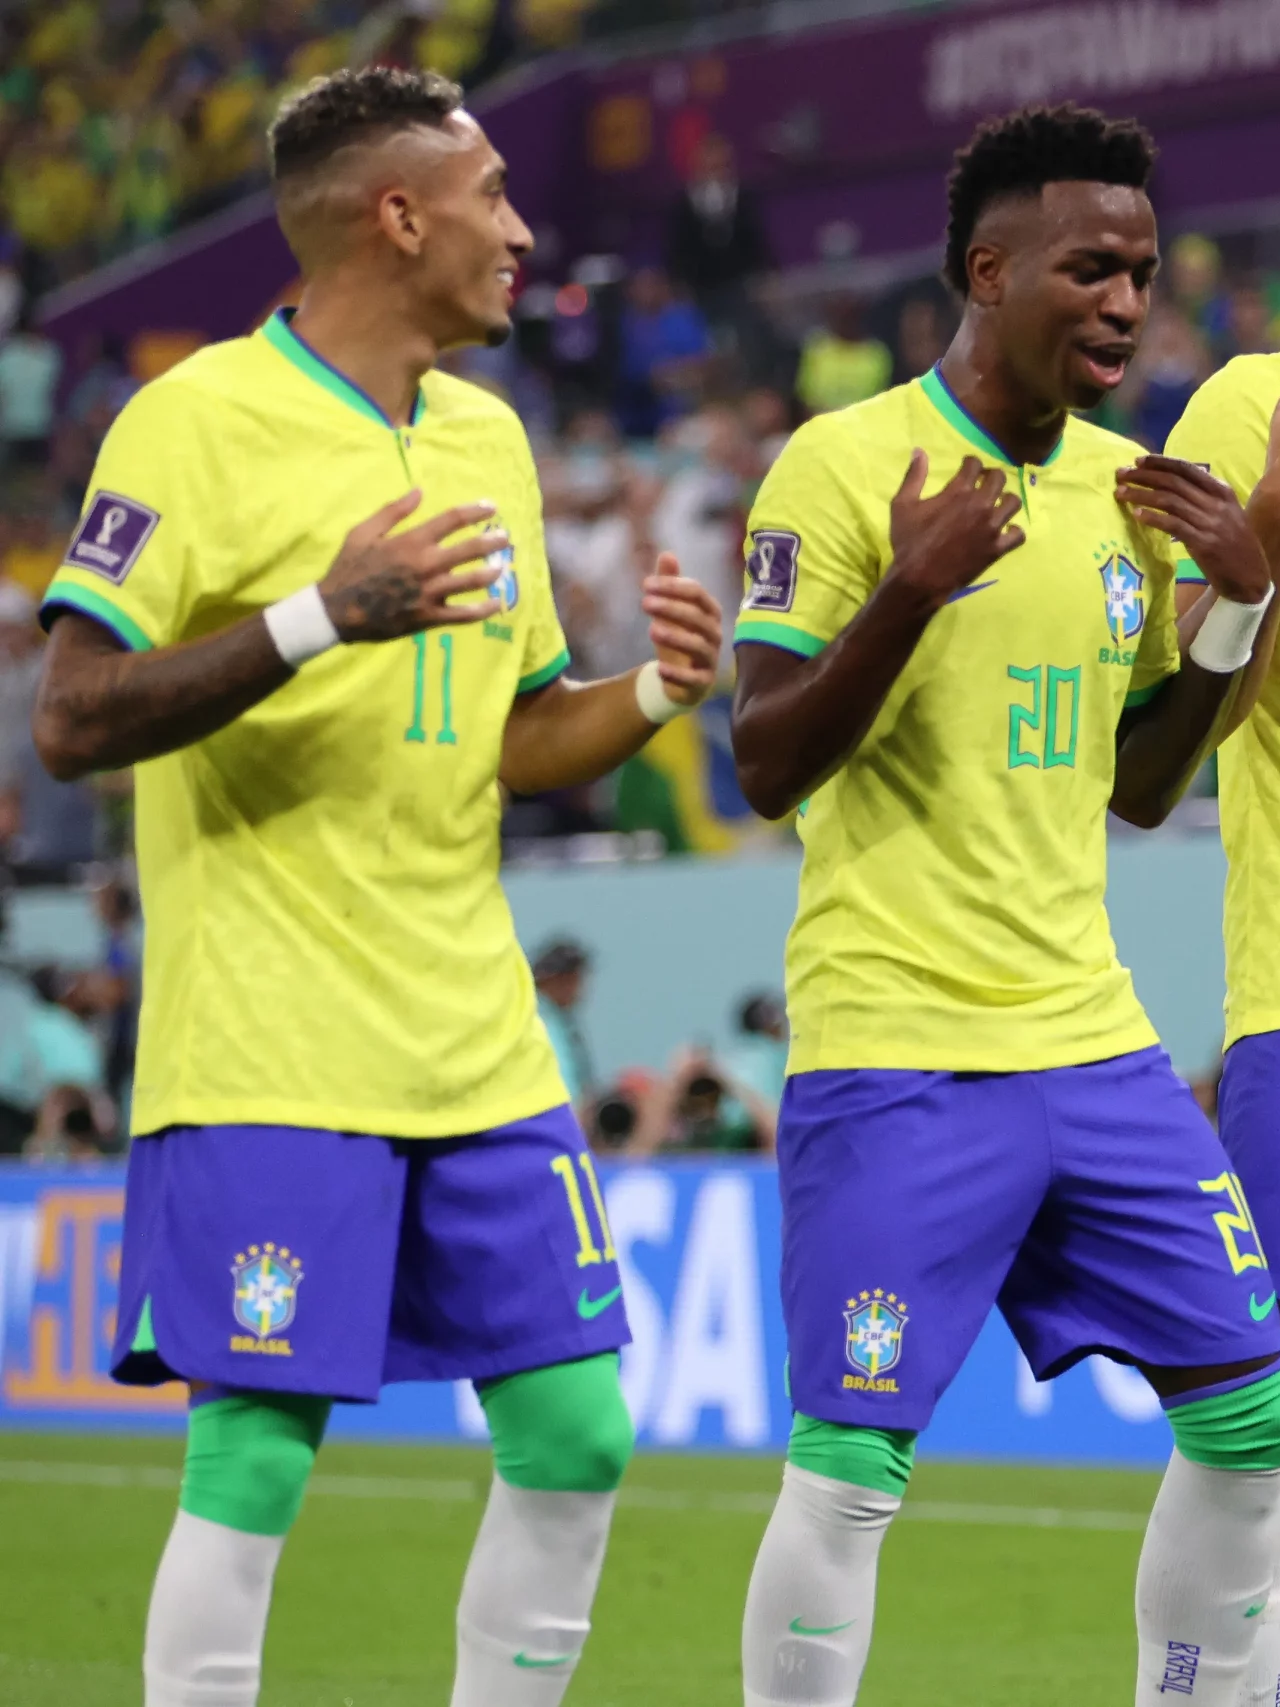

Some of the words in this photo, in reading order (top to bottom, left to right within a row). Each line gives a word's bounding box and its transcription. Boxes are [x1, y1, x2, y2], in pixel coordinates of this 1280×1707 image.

[1110, 590, 1127, 602] CBF
[404, 631, 457, 744] 11
[1007, 664, 1081, 770] 20
[550, 1153, 617, 1268] 11
[1197, 1170, 1268, 1276] 2
[863, 1331, 884, 1341] CBF
[842, 1374, 900, 1393] BRASIL
[1160, 1640, 1201, 1695] BRASIL
